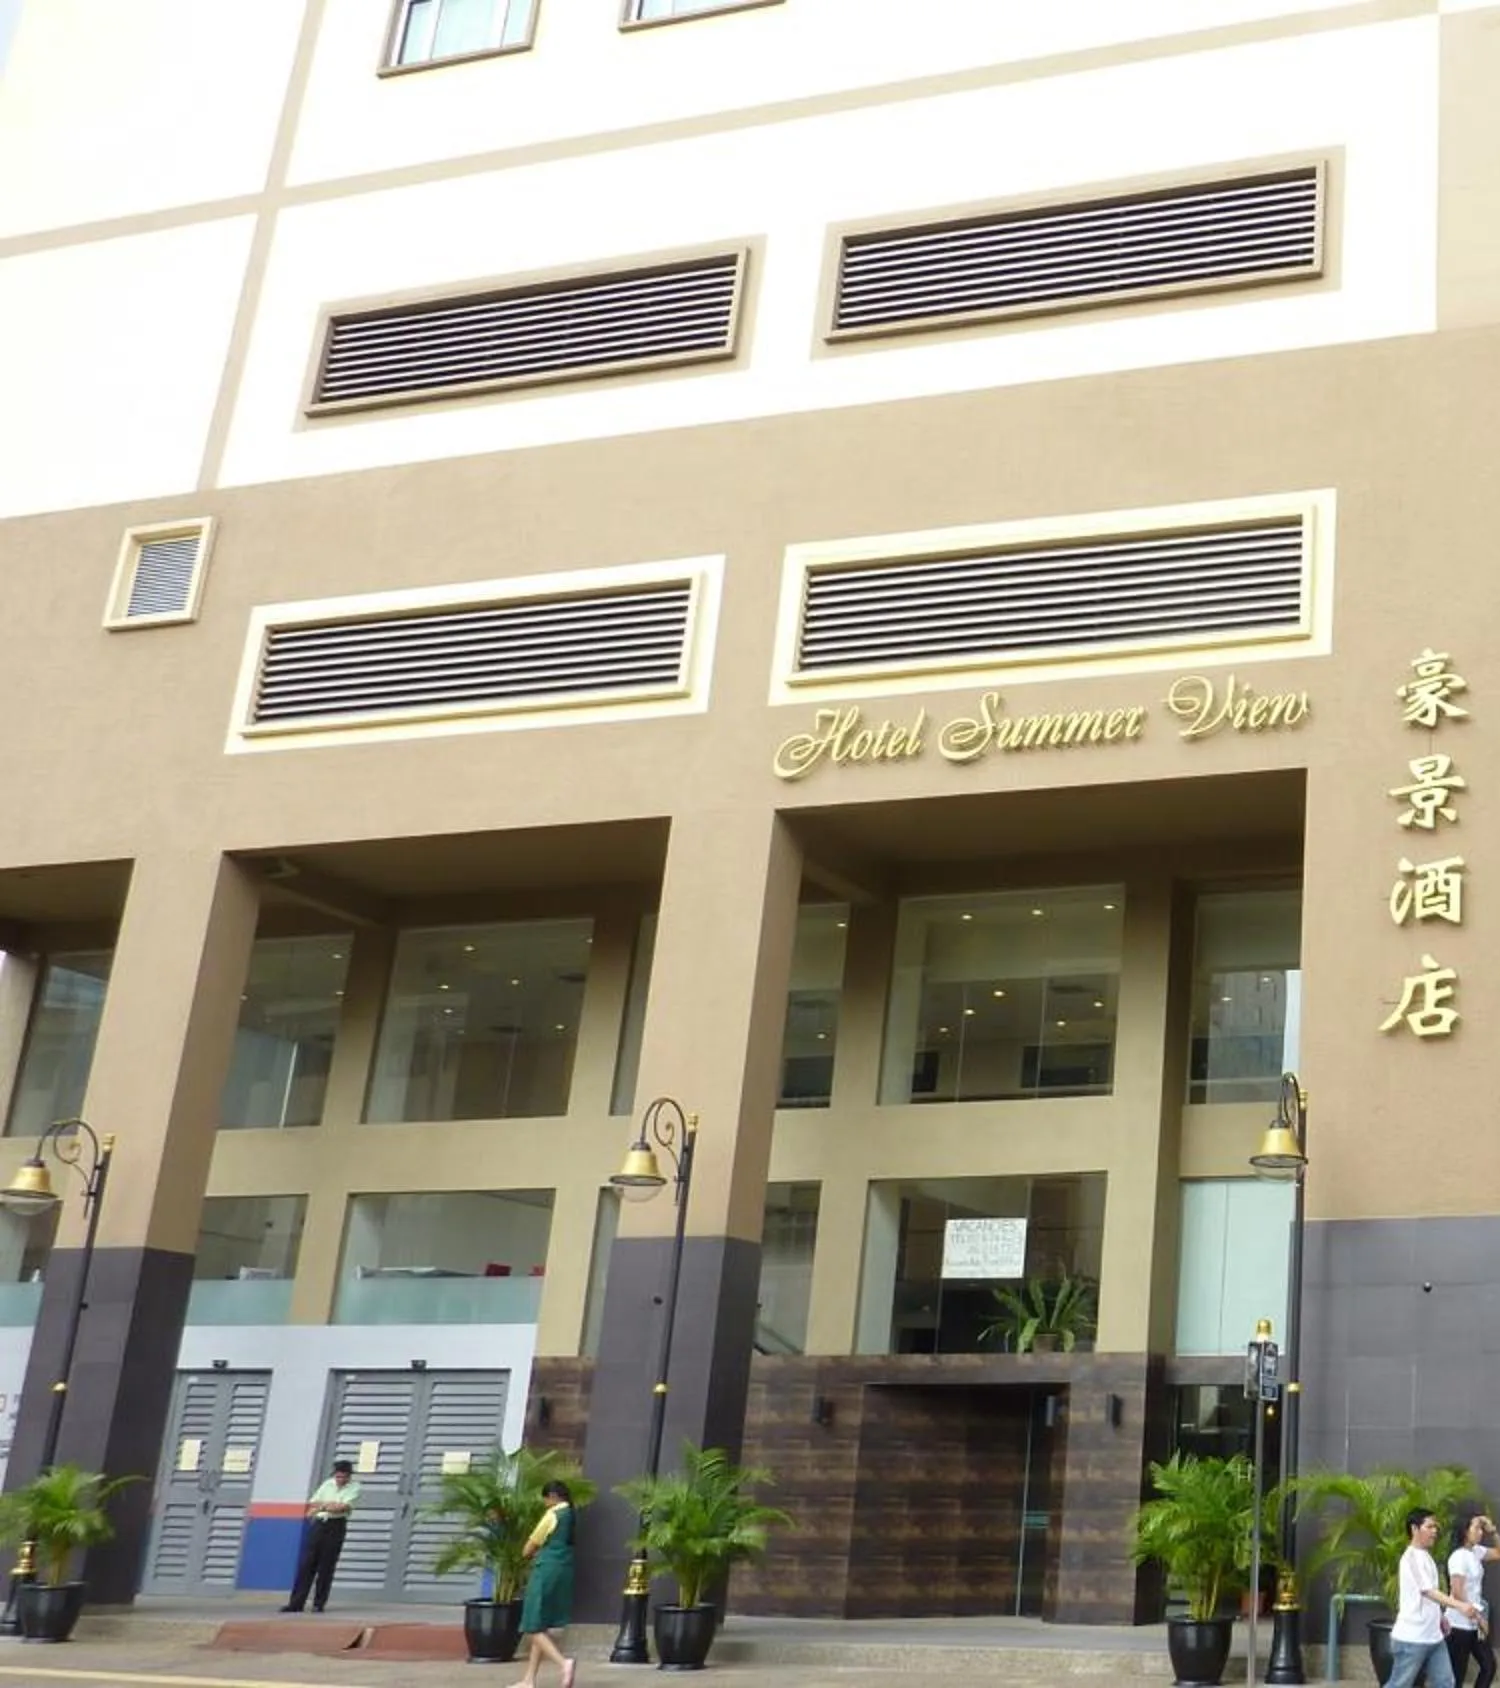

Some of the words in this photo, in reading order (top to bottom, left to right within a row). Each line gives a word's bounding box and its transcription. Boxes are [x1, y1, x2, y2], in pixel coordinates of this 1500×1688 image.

[773, 705, 926, 778] Hotel
[938, 691, 1145, 760] Summer
[1162, 672, 1309, 737] View
[1379, 648, 1470, 1037] 豪景酒店
